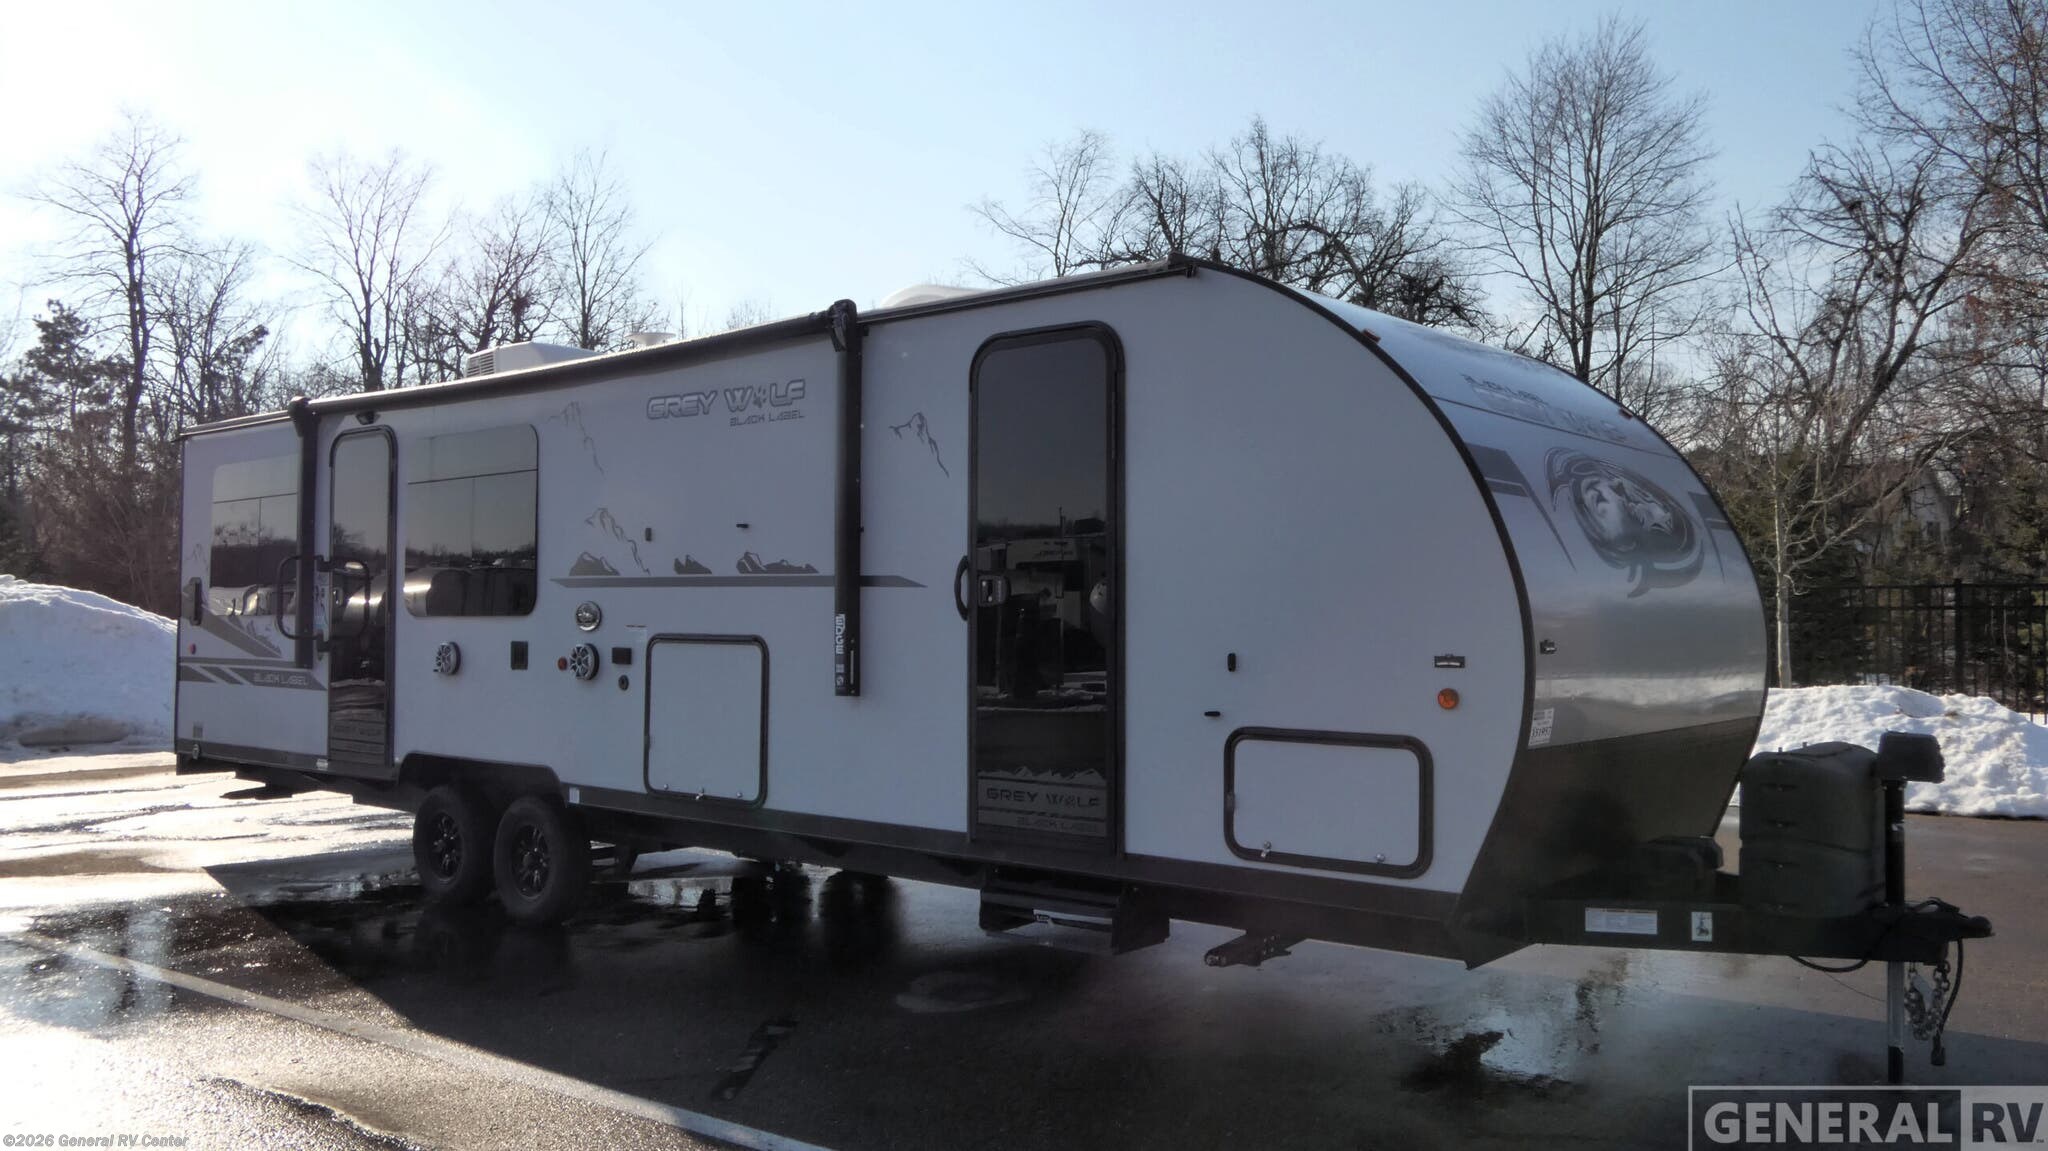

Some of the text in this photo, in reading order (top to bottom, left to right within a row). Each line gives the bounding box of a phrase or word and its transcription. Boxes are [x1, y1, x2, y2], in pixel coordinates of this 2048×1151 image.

[647, 390, 717, 420] GREY
[730, 410, 805, 427] BLACK LABEL
[835, 614, 845, 654] EDGE
[986, 788, 1038, 802] GREY
